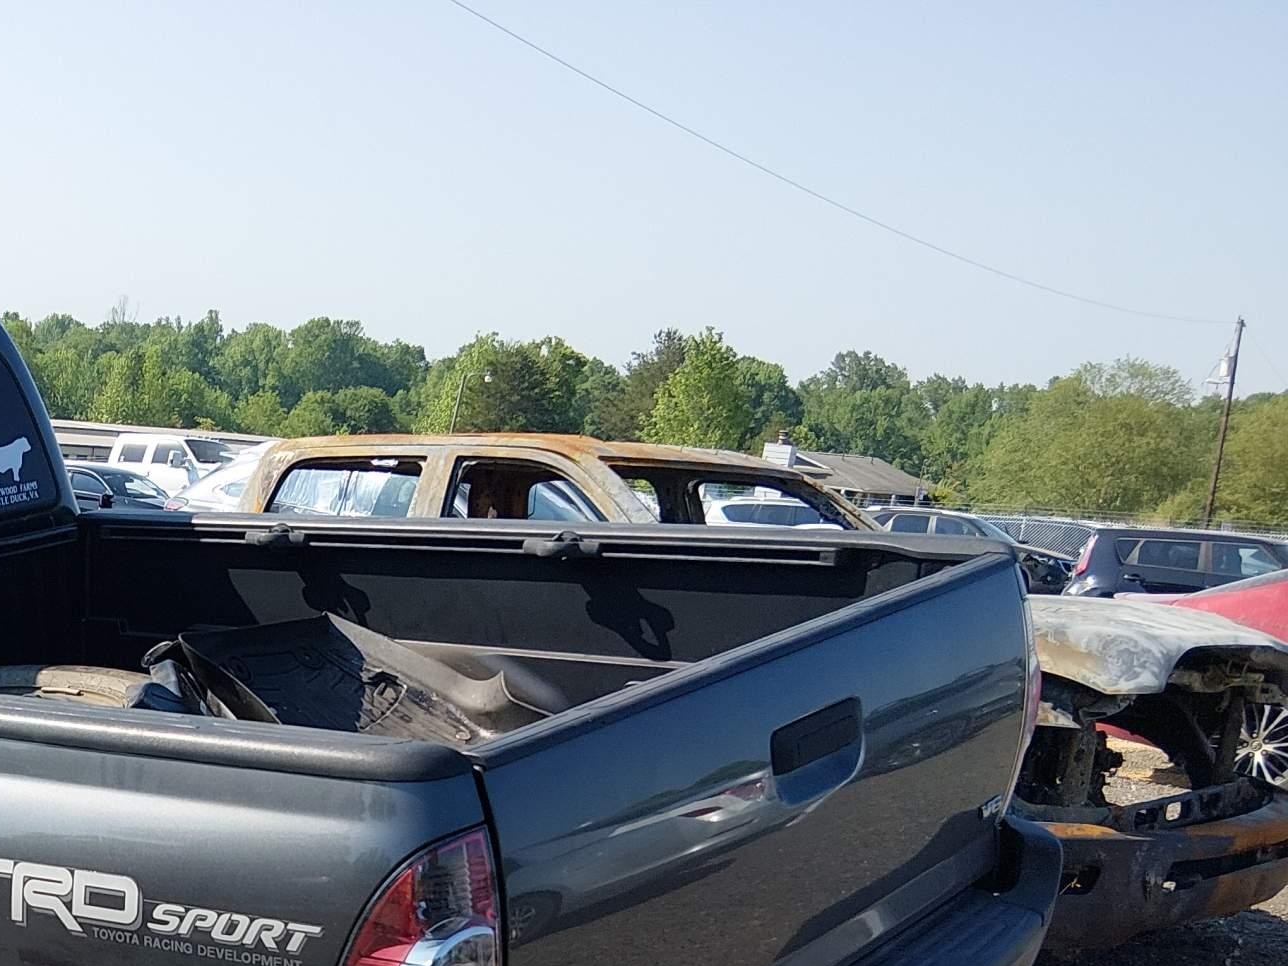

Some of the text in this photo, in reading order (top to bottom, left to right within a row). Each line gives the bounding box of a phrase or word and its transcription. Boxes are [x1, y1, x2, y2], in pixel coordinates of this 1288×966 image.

[19, 481, 38, 493] FARMS
[92, 926, 140, 947] TOYOTA
[143, 934, 194, 955] RACING
[146, 903, 325, 954] SPORT
